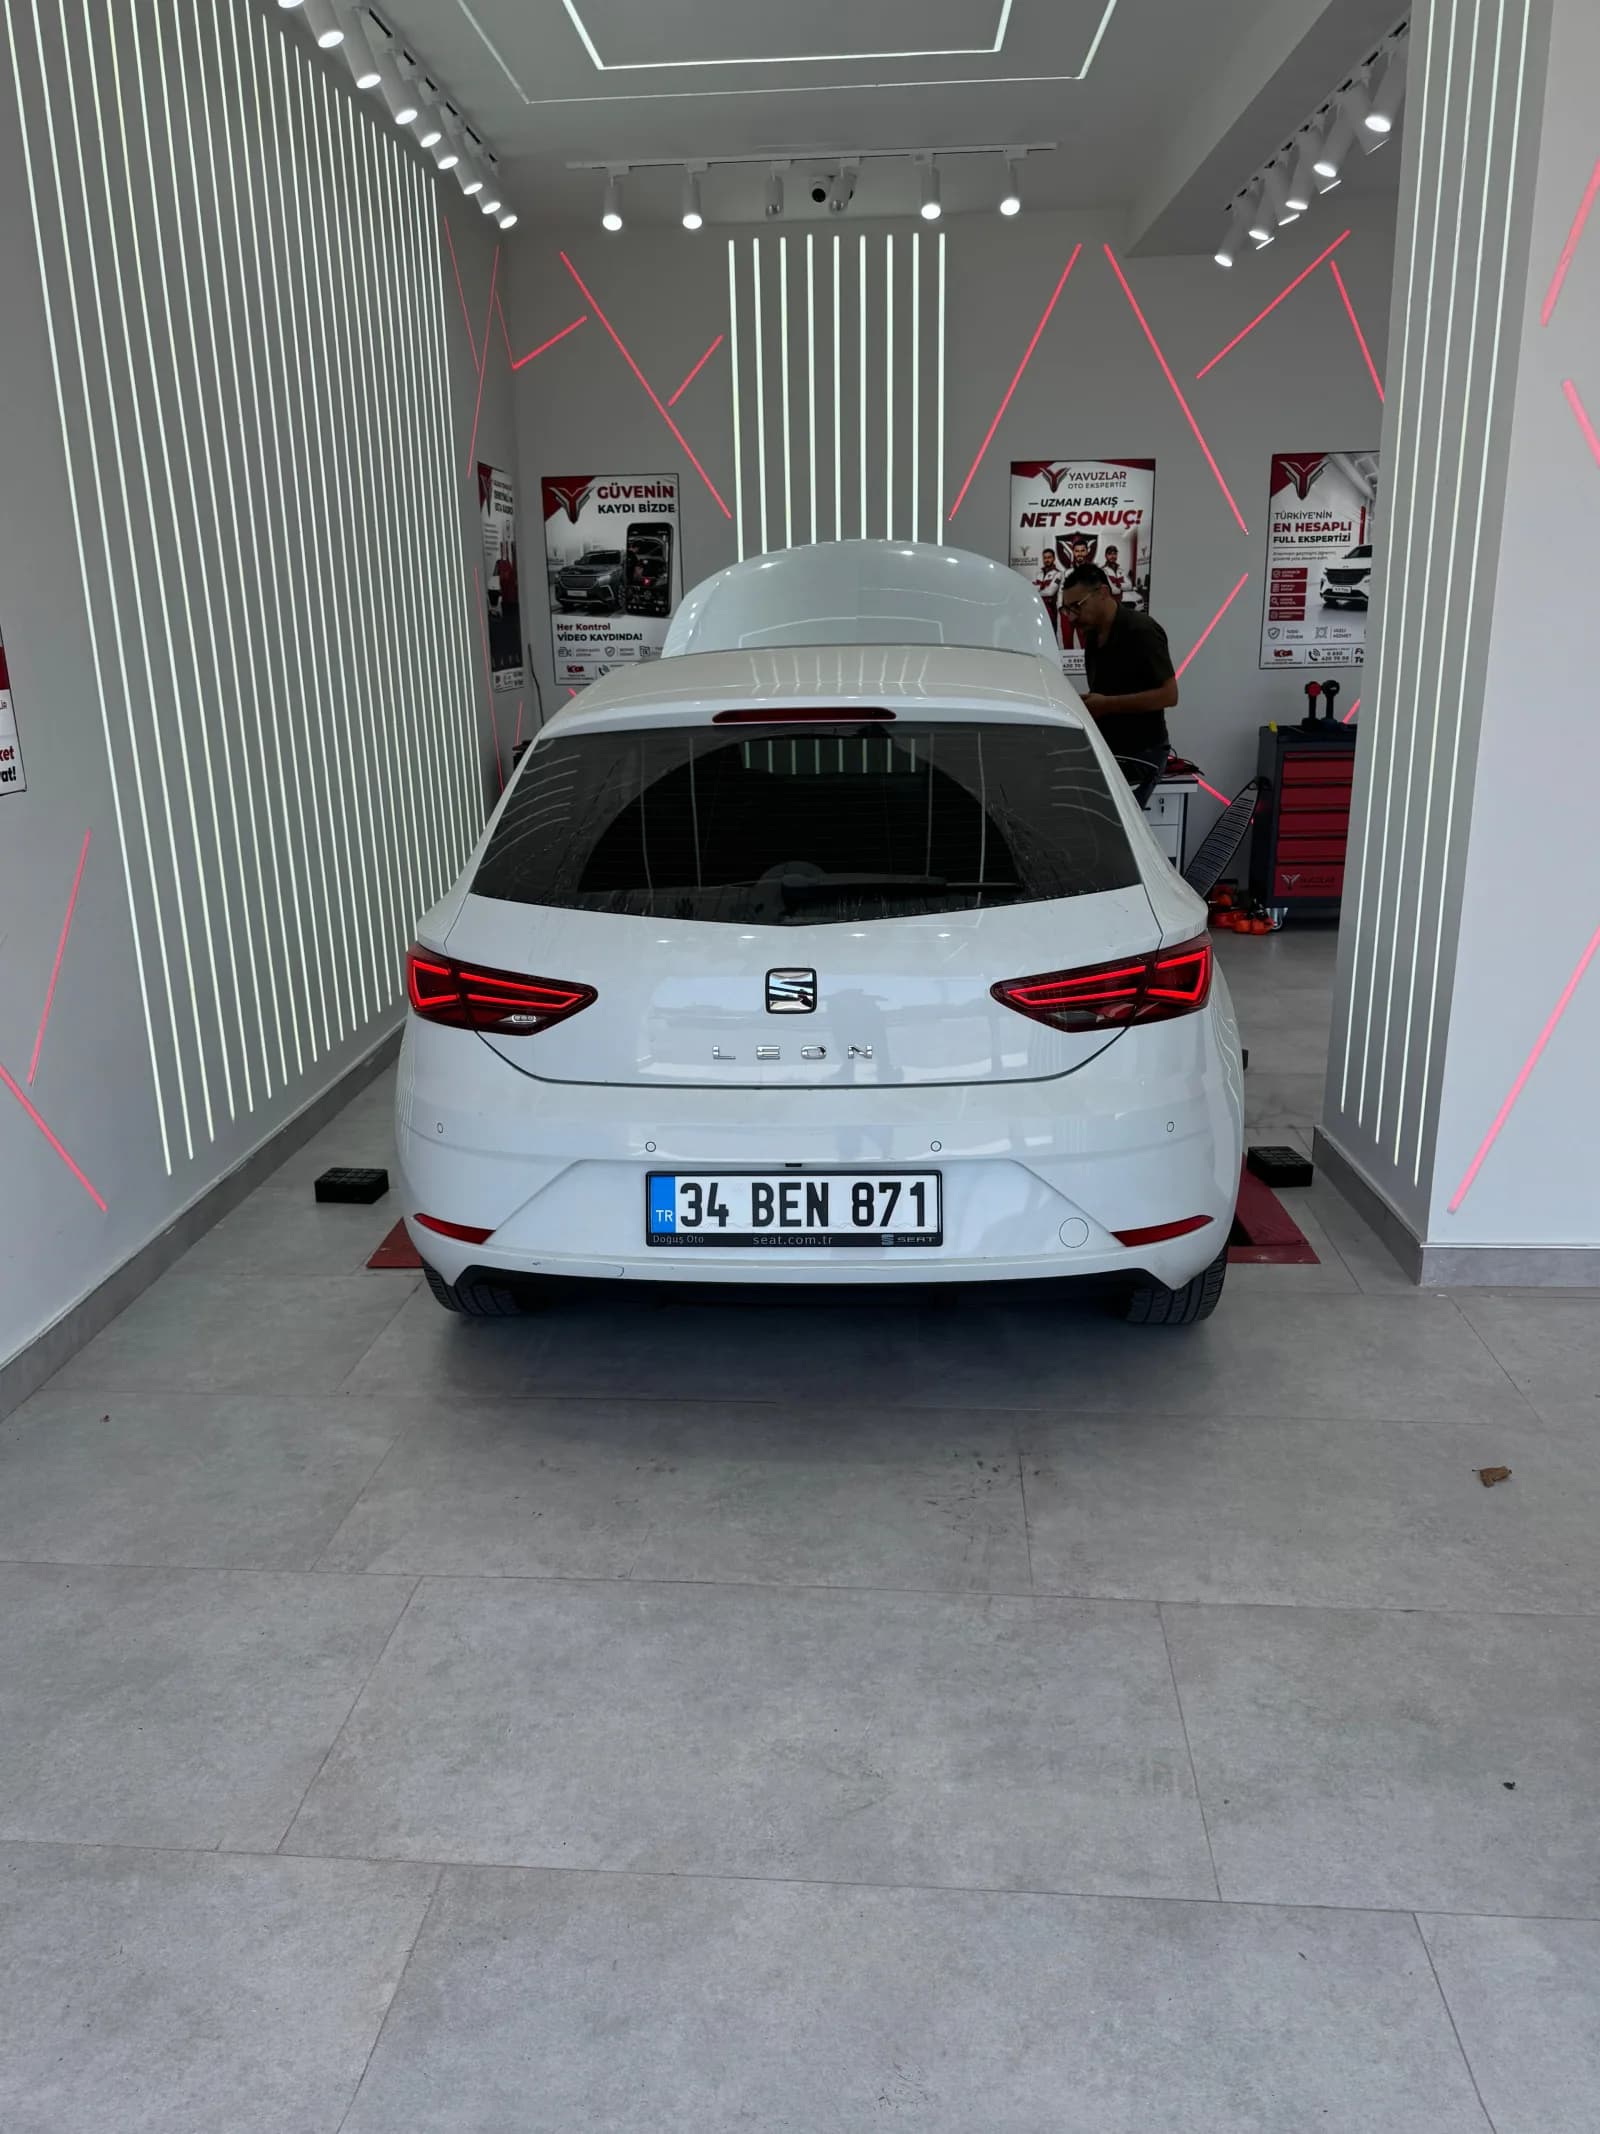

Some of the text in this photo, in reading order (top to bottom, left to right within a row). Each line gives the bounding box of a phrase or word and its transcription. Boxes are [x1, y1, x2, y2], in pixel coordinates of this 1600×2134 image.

[1069, 471, 1127, 481] YAVUZLAR
[597, 481, 674, 500] GÜVENİN
[1085, 481, 1127, 489] EKSPERTİZ
[598, 500, 675, 514] KAYDI BİZDE
[1041, 497, 1119, 508] UZMAN BAKIŞ
[1020, 510, 1143, 529] NET SONUÇ!
[1275, 510, 1333, 520] TÜRKİYE'NİN
[1273, 521, 1352, 533] EN HESAPLI
[1273, 532, 1351, 544] FULL EKSPERTİZİ
[556, 622, 611, 631] Her Kontrol
[557, 632, 643, 642] VİDEO KAYDINDA!
[712, 1045, 873, 1060] LEON
[680, 1181, 925, 1228] 34 BEN 871
[655, 1209, 673, 1223] TR
[653, 1234, 704, 1245] Doğuş Oto
[752, 1235, 833, 1246] seat.com.tr
[897, 1236, 936, 1244] SEAT
